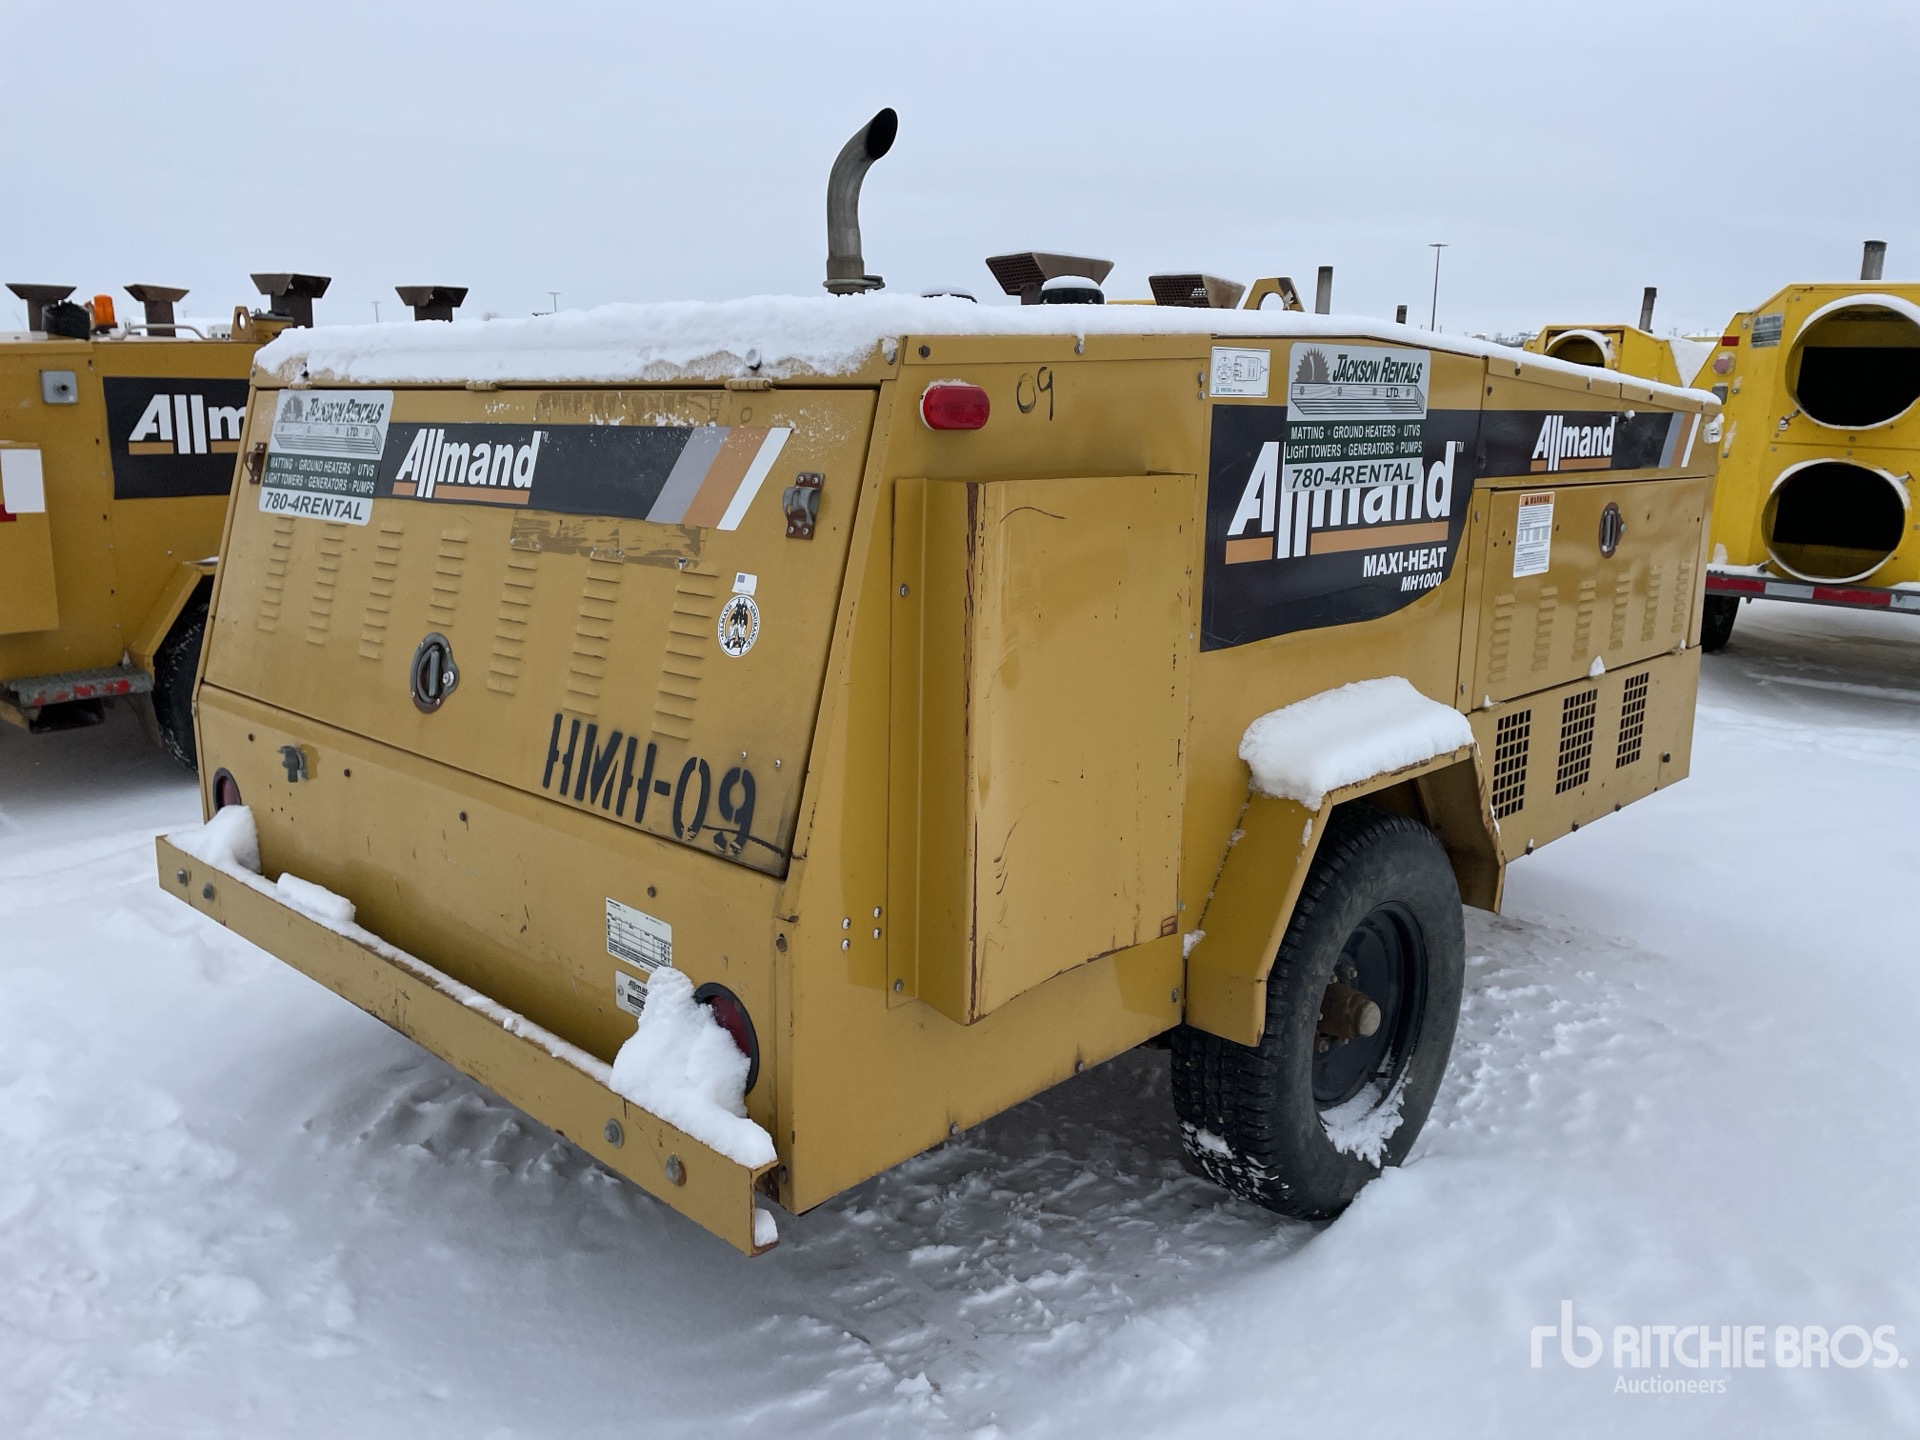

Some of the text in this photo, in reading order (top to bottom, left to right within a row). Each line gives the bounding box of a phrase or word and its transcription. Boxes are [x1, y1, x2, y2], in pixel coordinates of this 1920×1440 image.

[1332, 354, 1422, 383] JACKSON RENTALS
[1016, 366, 1053, 421] 09
[1386, 388, 1400, 398] LTD.
[128, 394, 247, 454] Allm
[1291, 424, 1420, 440] MATTING GROUND HEATERS UTVS
[1286, 441, 1423, 459] LIGHT TOWERS GENERATORS PUMPS
[1531, 415, 1616, 471] Allmand
[270, 457, 375, 477] MATTING GROUND HEATERS UTVS
[395, 428, 542, 498] Allmand
[1292, 463, 1414, 489] 780-4RENTAL
[265, 472, 375, 494] LIGHT TOWERS GENERATORS PUMPS
[265, 492, 363, 520] 780-4RENTAL
[1363, 547, 1447, 577] MAXI-HEAT
[1401, 571, 1442, 592] MH1000
[542, 713, 756, 856] HMH-09
